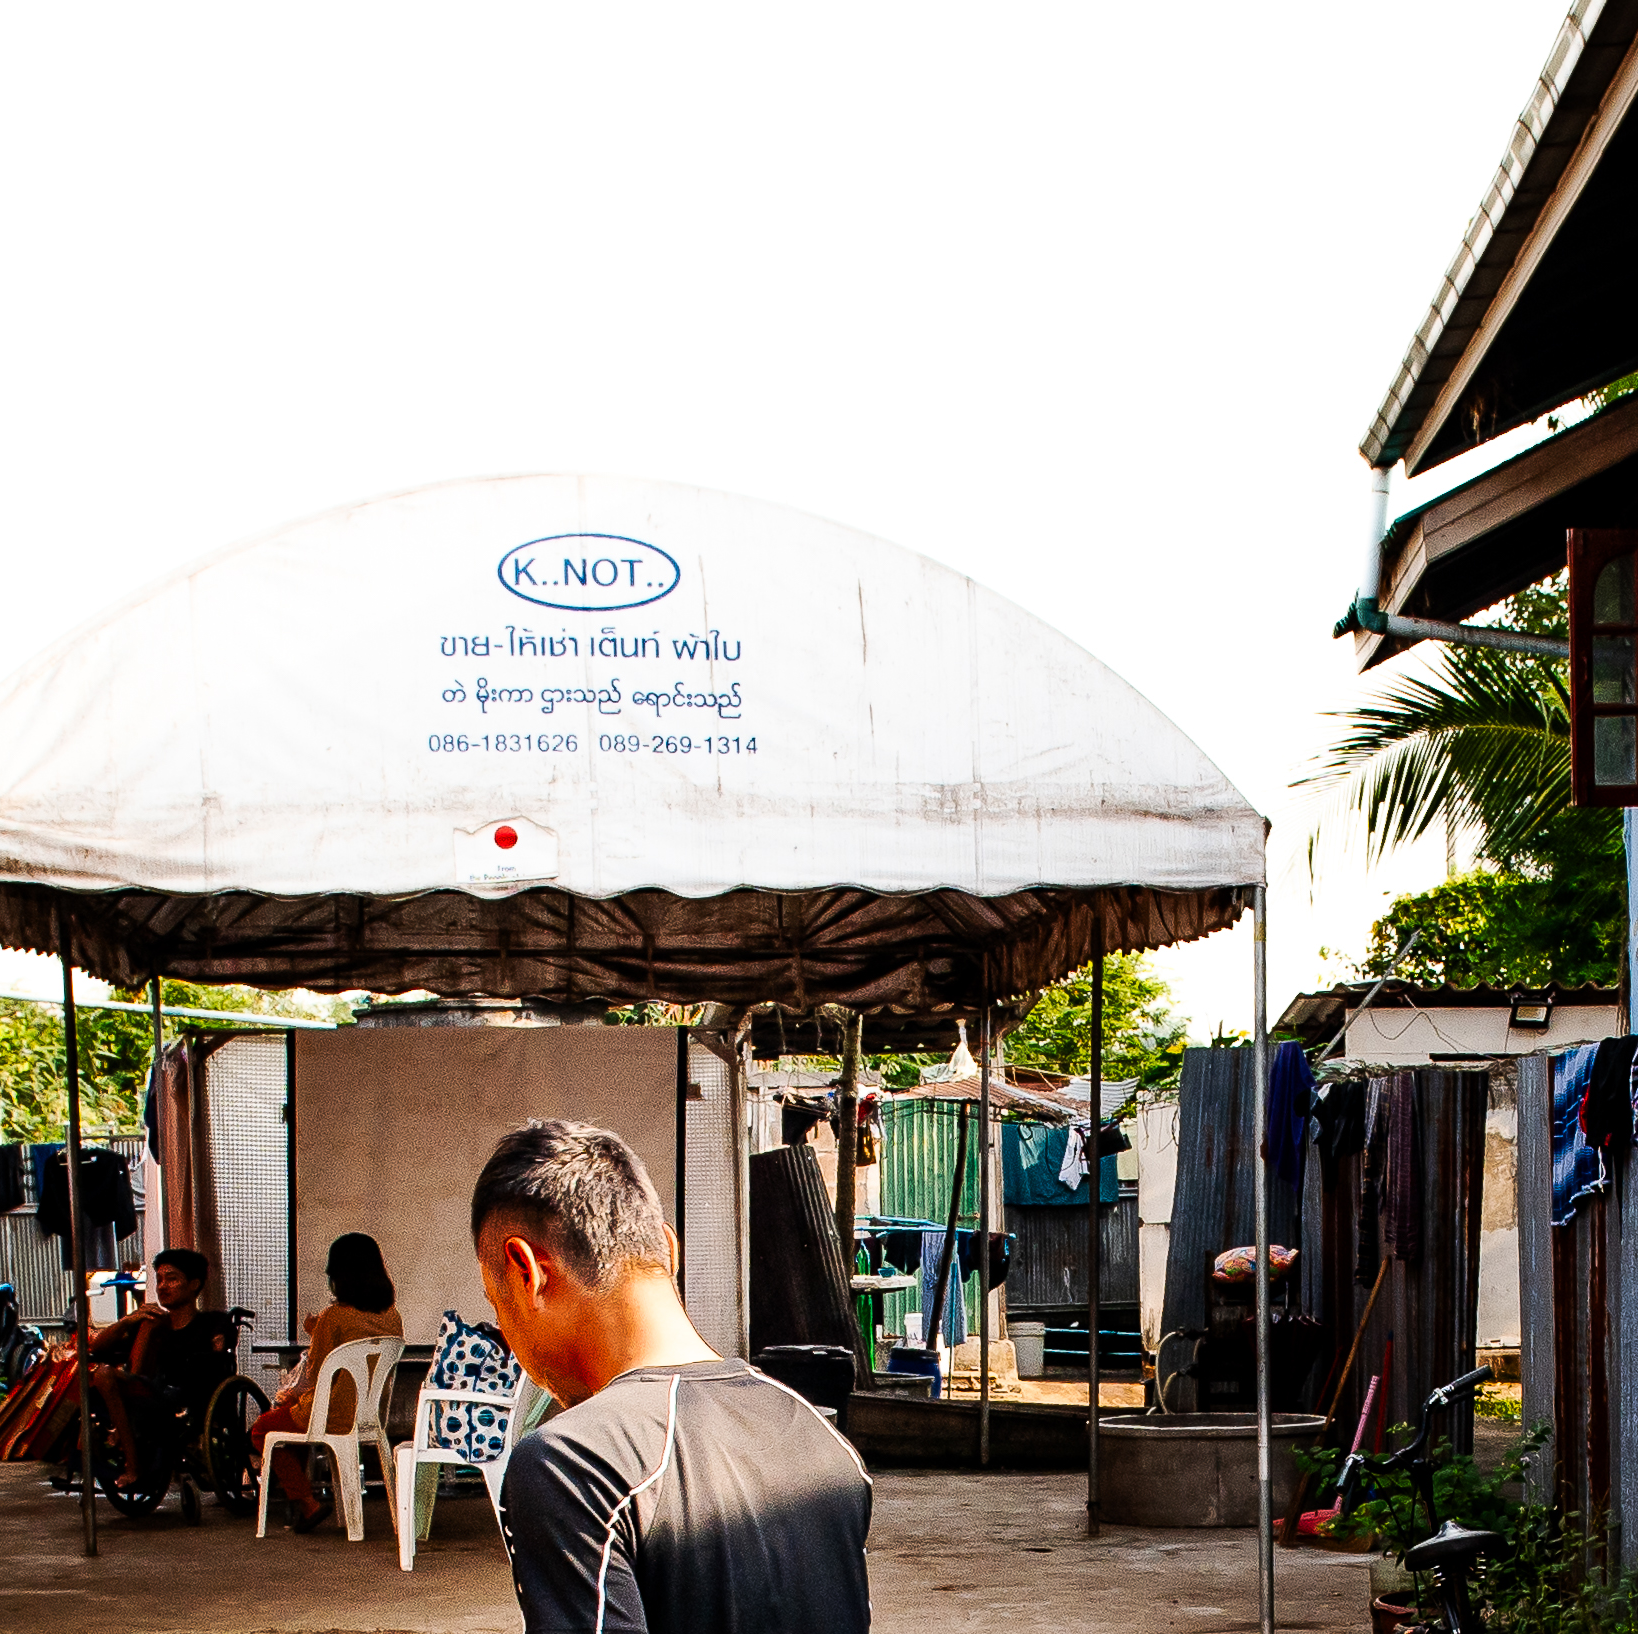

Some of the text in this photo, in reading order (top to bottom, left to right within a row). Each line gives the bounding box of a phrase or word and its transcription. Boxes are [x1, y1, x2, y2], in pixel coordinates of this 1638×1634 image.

[590, 626, 660, 658] เต็นท์
[672, 629, 741, 661] ผ้าใบ
[428, 734, 758, 755] 086-1831626 089-269-1314
